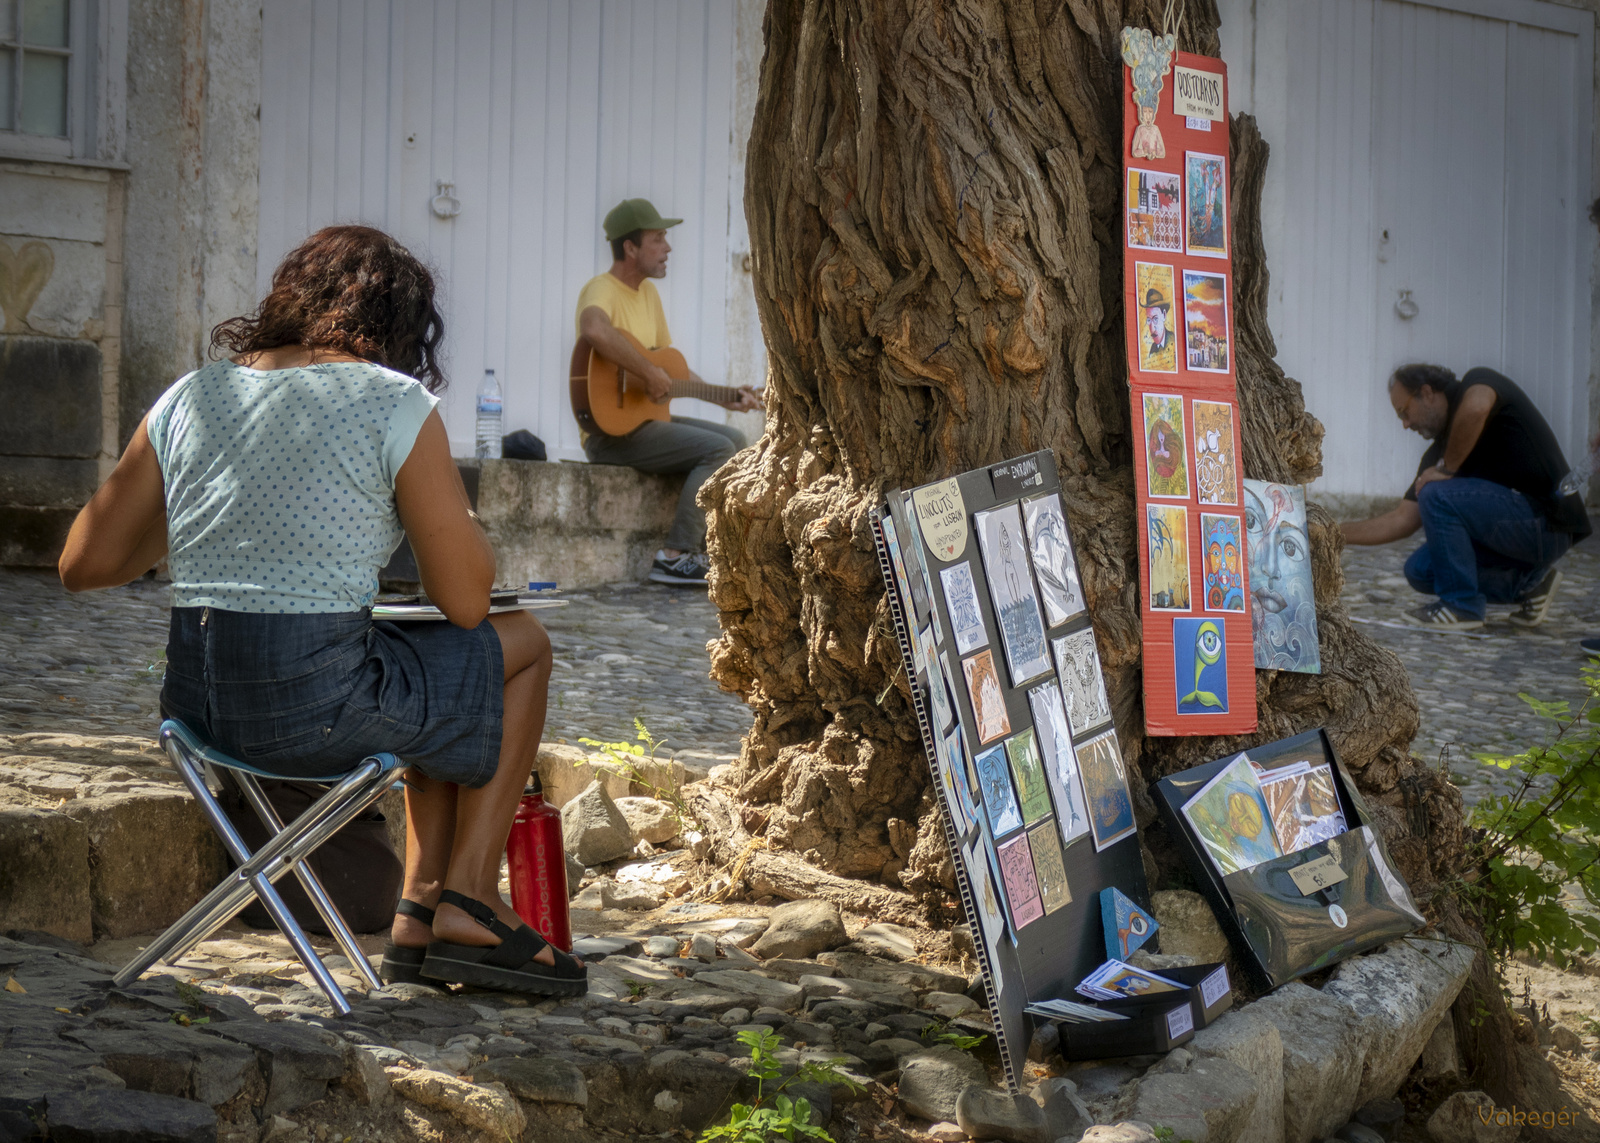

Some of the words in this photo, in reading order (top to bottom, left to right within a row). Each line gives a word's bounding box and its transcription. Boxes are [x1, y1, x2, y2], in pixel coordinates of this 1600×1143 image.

[1177, 72, 1219, 106] POSTCARDS
[1187, 103, 1196, 112] FROM
[919, 493, 953, 519] LINOCUTS
[942, 509, 964, 527] LISBON
[535, 844, 553, 936] Quechua
[1312, 872, 1327, 887] 5€
